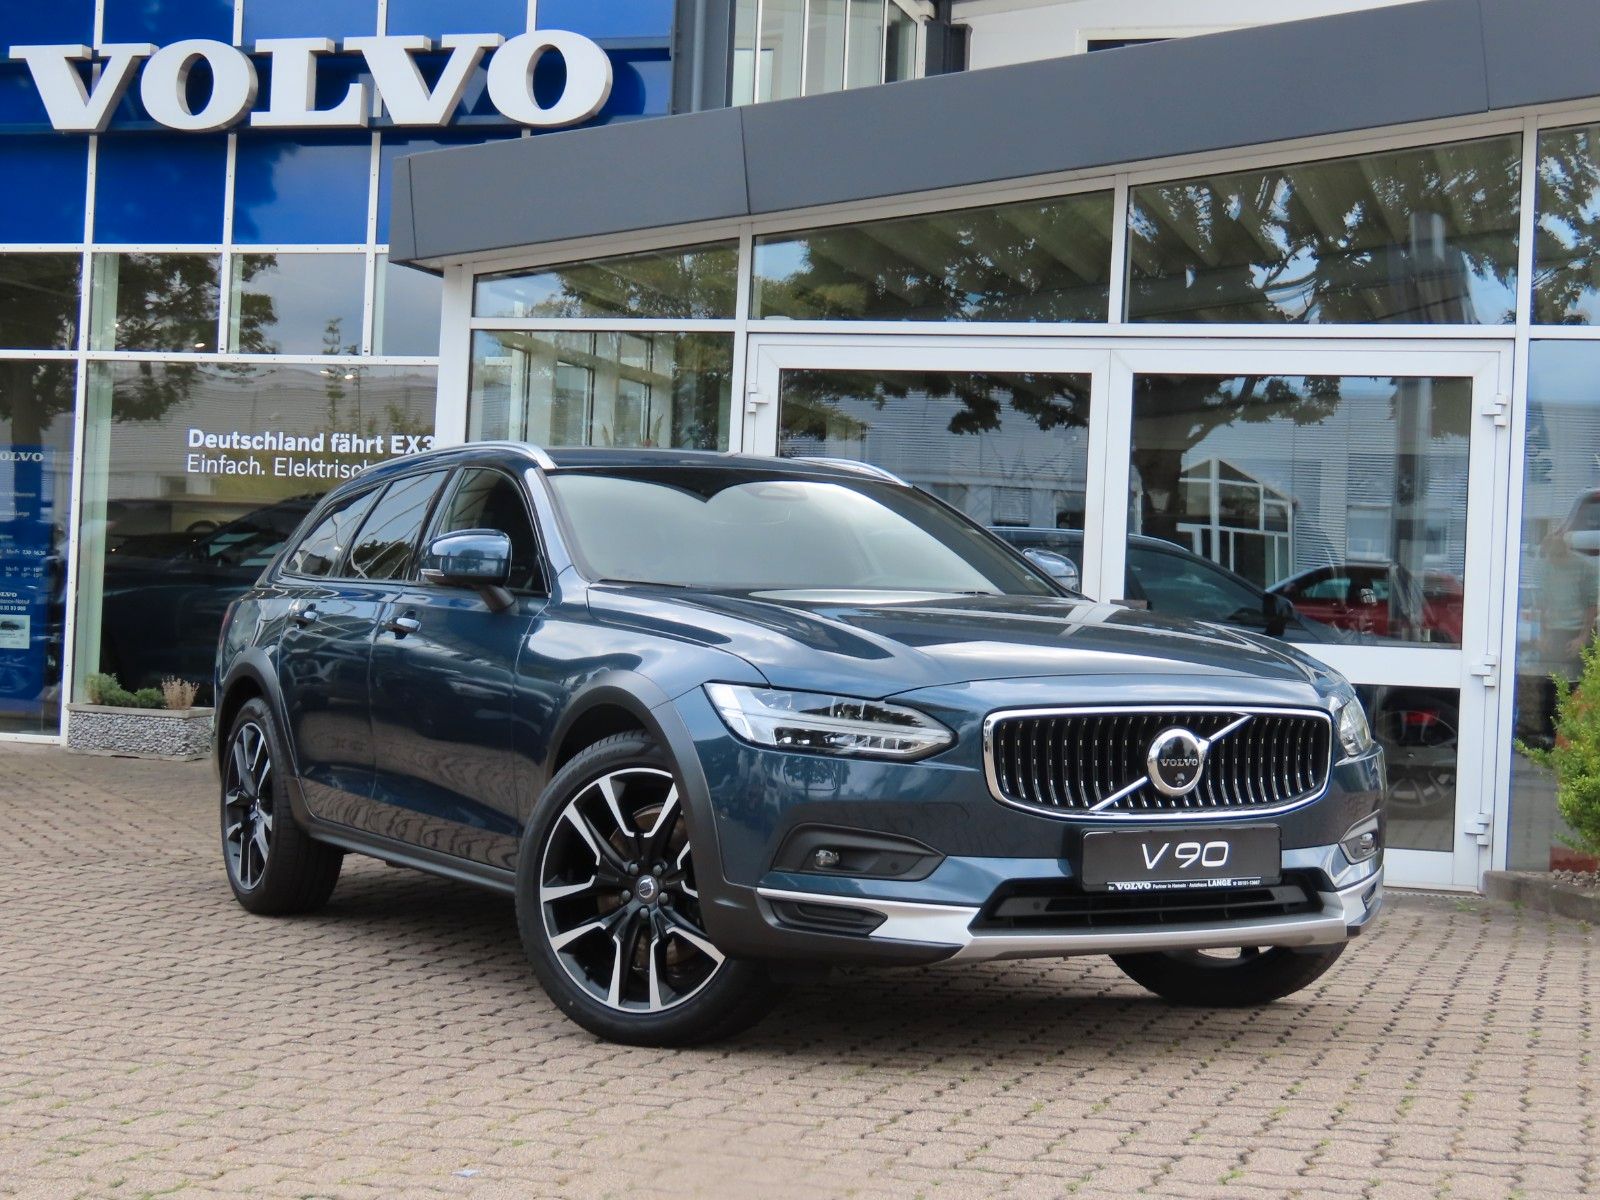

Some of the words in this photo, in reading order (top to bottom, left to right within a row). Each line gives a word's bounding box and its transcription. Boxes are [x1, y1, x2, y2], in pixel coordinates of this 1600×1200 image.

[9, 29, 613, 132] VOLVO
[188, 429, 325, 452] Deutschland
[331, 433, 383, 453] fährt
[187, 454, 266, 475] Einfach.
[1160, 758, 1198, 767] VOLVO
[1141, 843, 1170, 870] V
[1174, 841, 1229, 868] 90
[1115, 882, 1151, 890] VOLVO
[1208, 879, 1232, 887] LANGE
